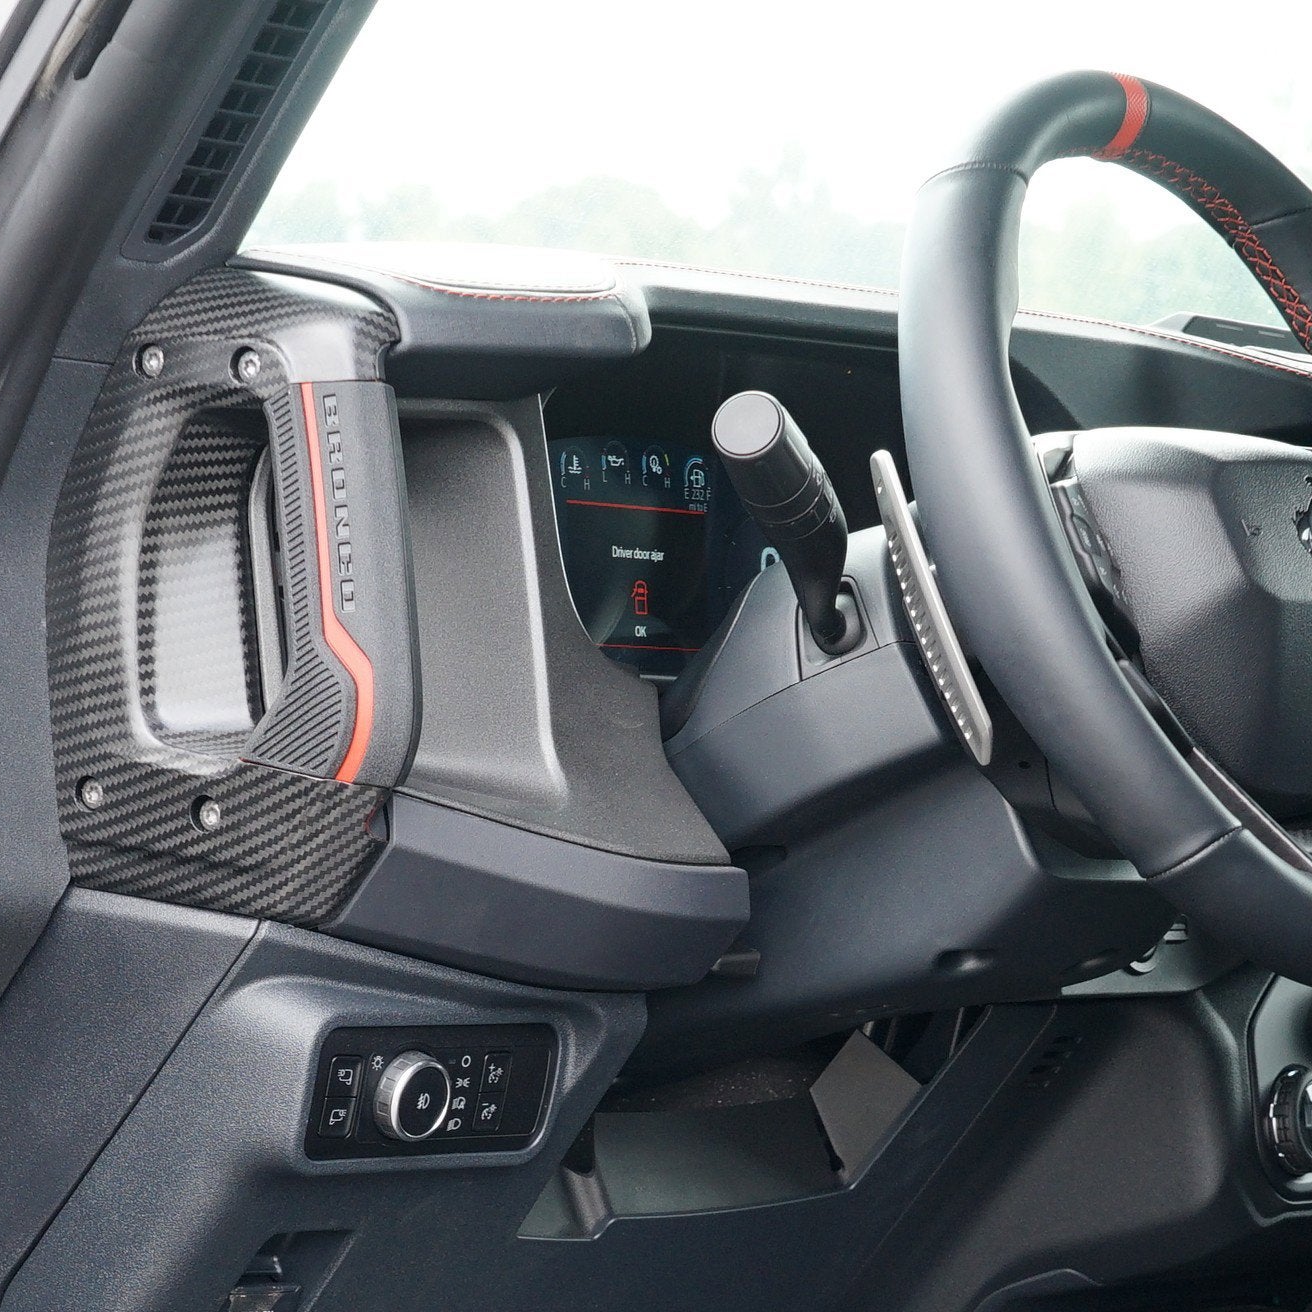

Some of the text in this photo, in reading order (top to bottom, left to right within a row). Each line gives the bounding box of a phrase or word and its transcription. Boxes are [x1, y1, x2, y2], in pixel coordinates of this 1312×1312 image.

[560, 477, 591, 491] C H
[624, 473, 631, 485] H
[642, 475, 671, 489] C H
[691, 489, 705, 501] 232
[322, 393, 356, 614] BRONCO
[611, 545, 665, 563] Driver door ajar
[634, 625, 647, 638] OK
